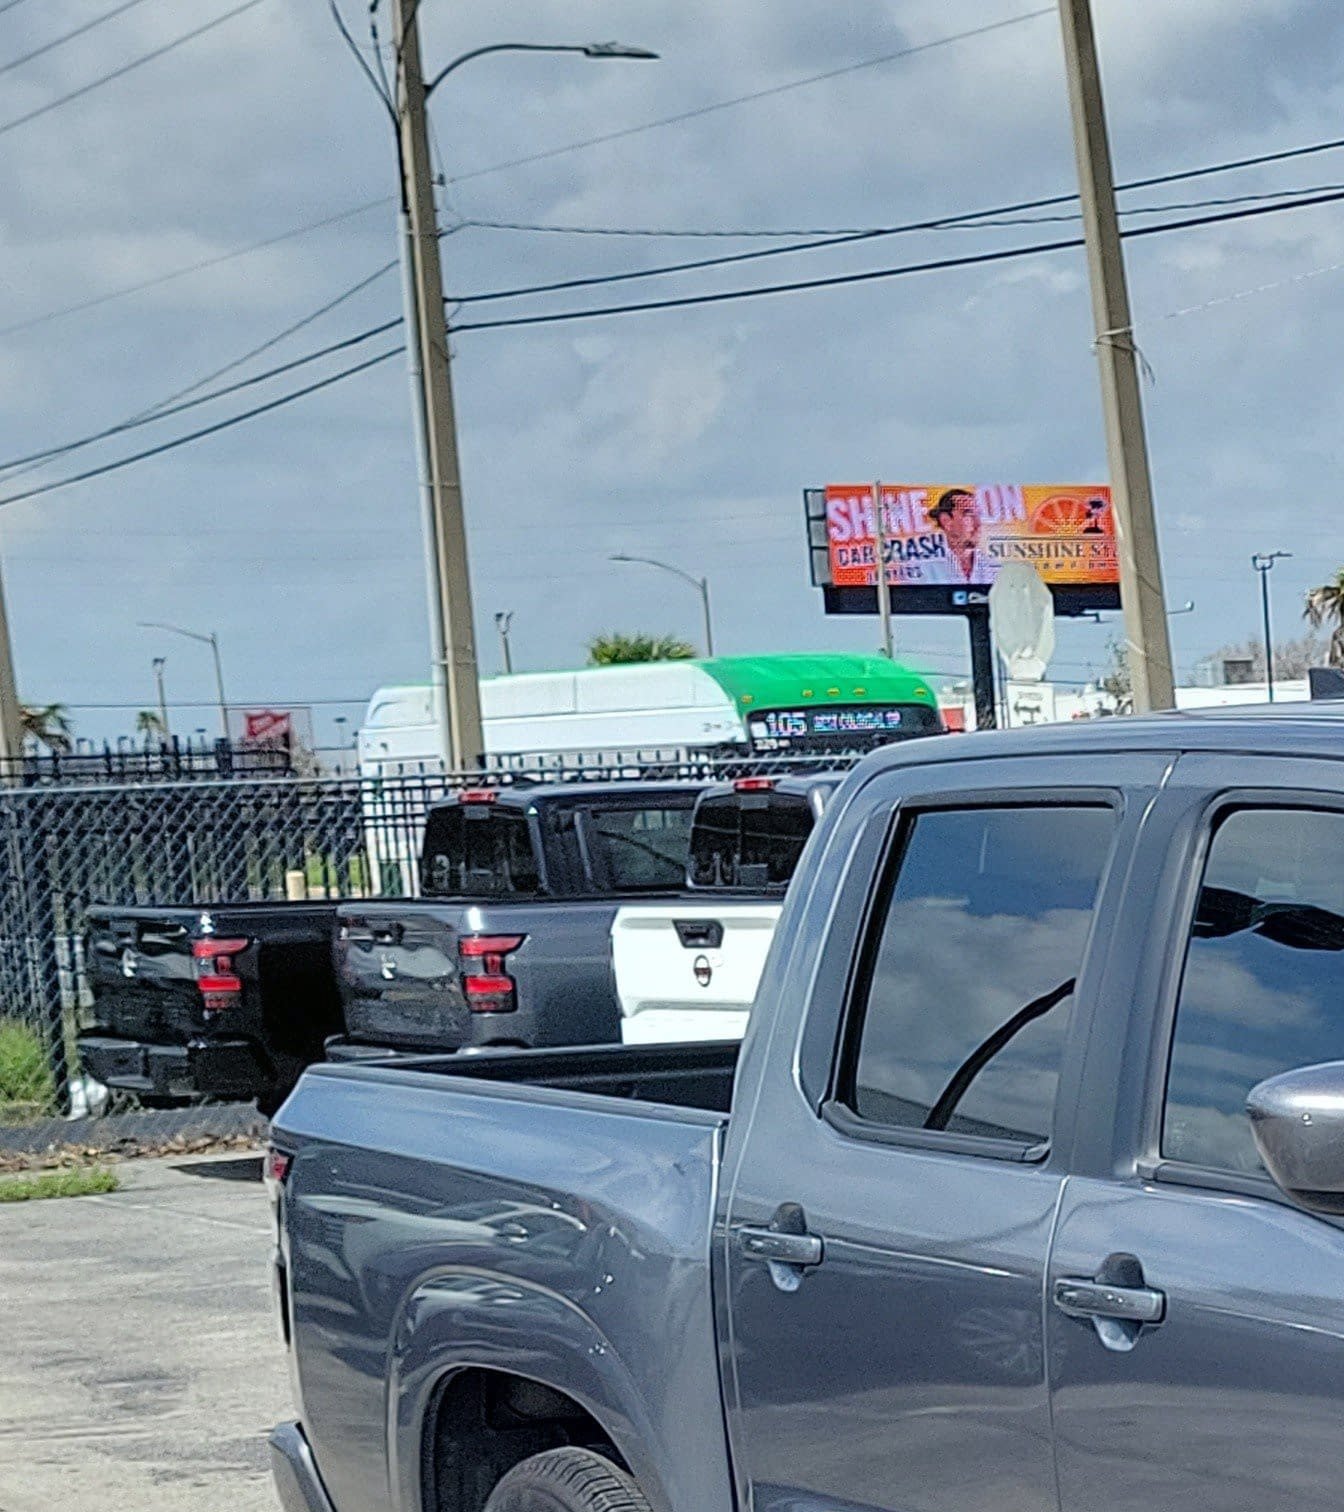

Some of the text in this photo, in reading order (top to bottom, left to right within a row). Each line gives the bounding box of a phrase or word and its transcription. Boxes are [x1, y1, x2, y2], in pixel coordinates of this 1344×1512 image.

[976, 484, 1026, 523] ON
[838, 545, 877, 566] CAR
[988, 543, 1086, 559] SUNSHINE
[766, 712, 808, 736] 105
